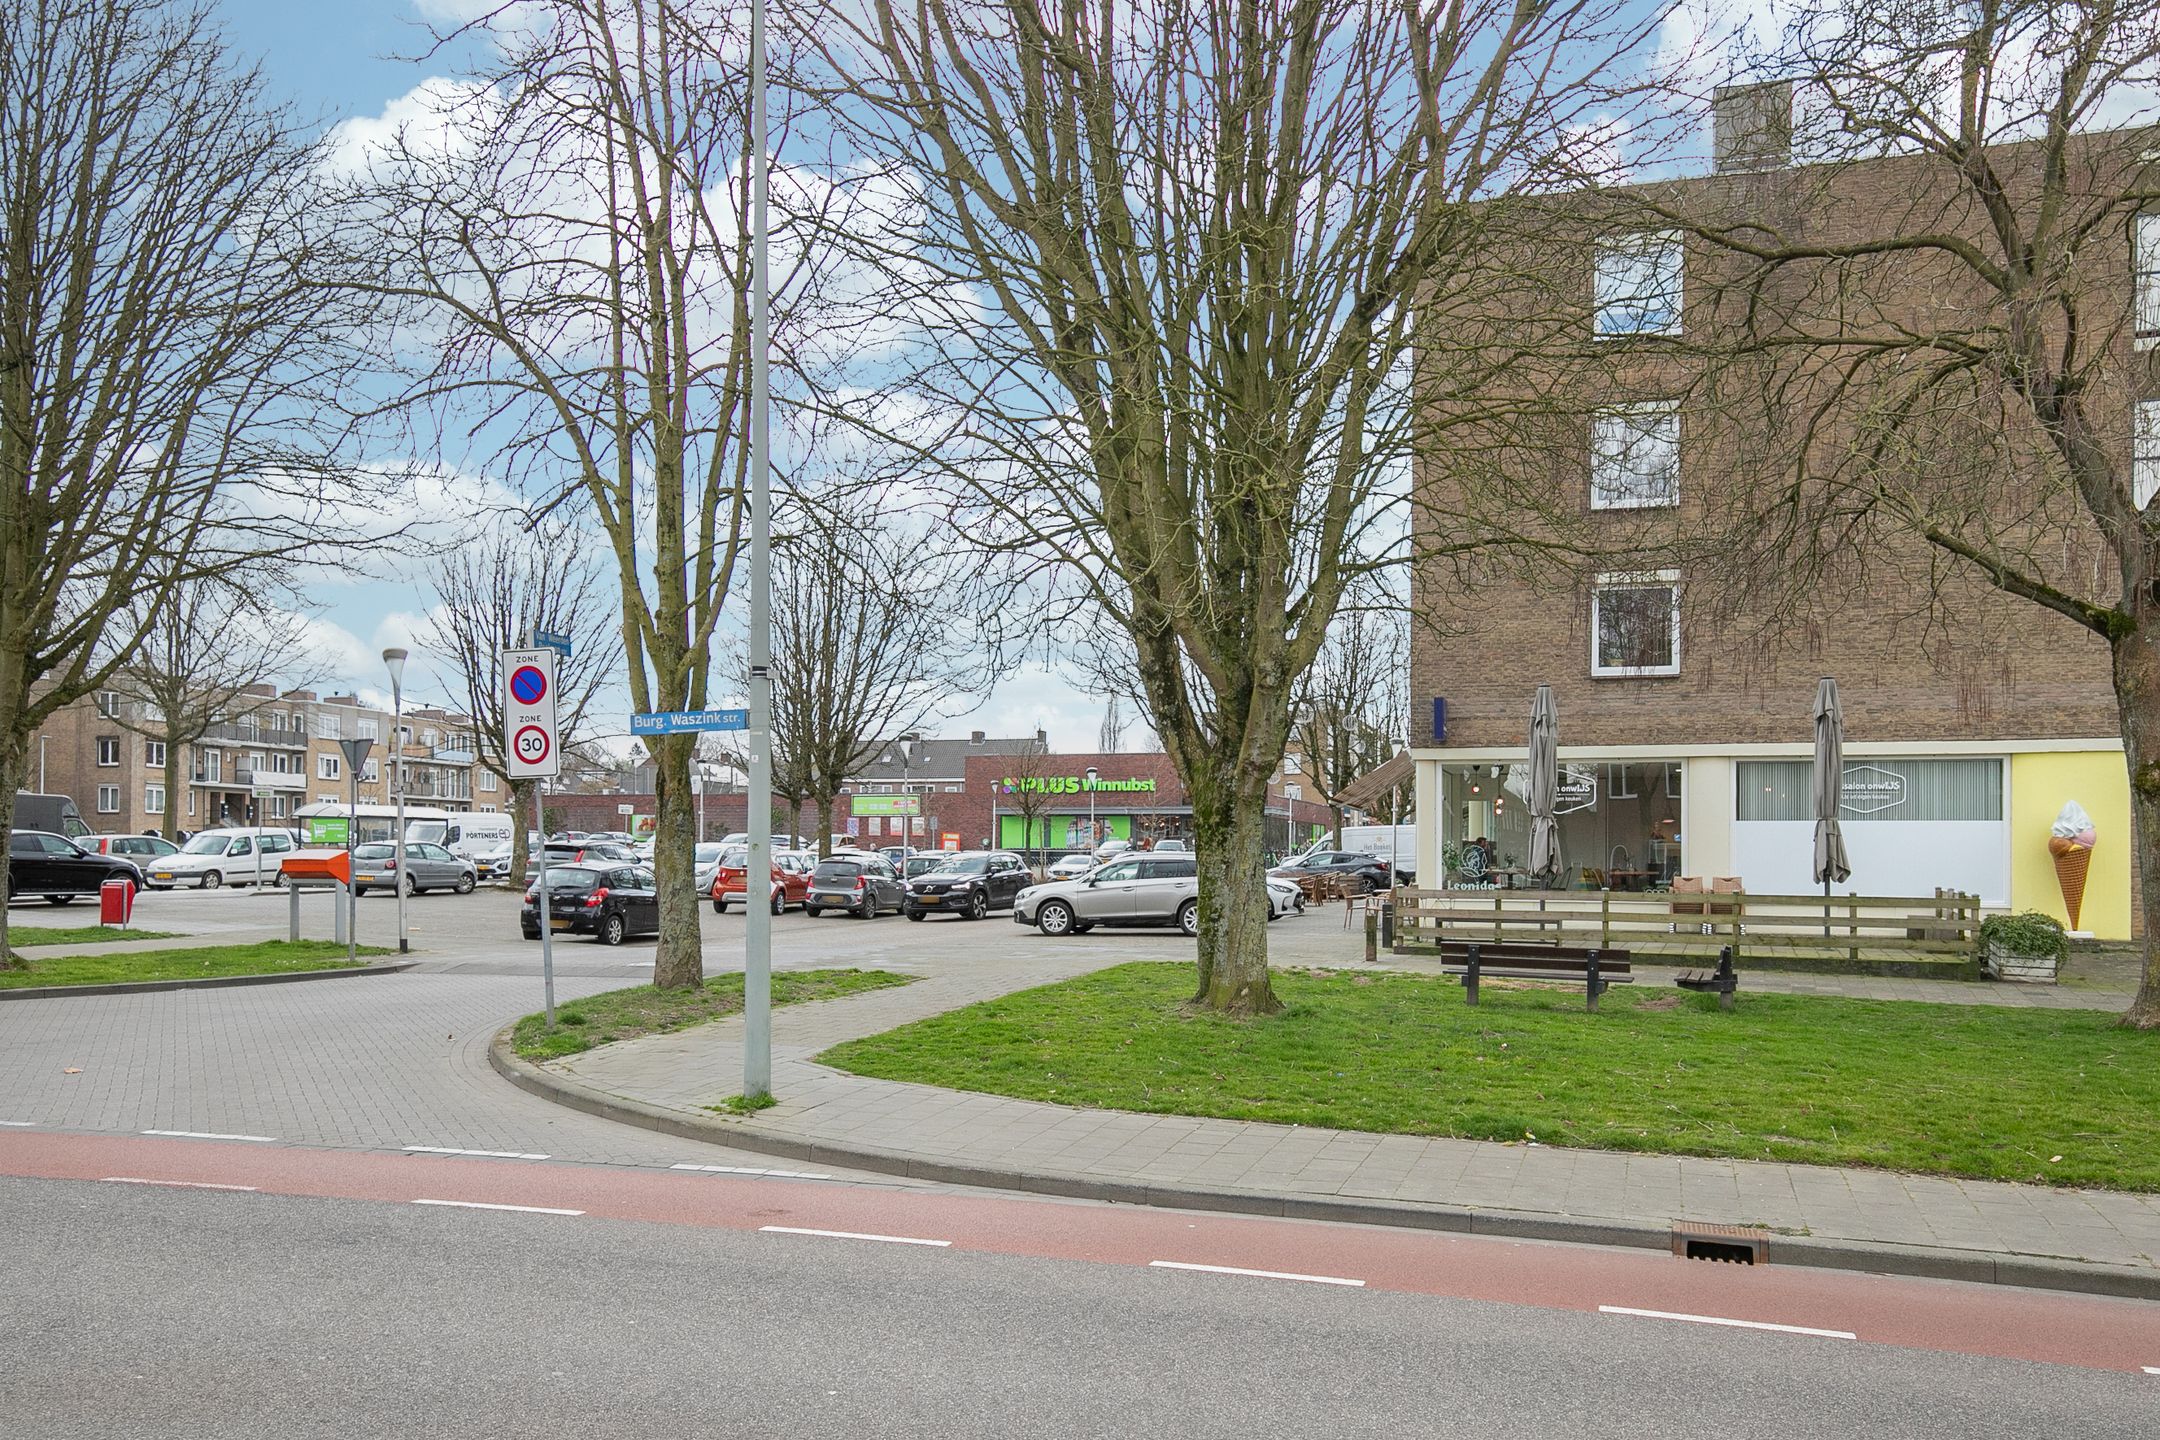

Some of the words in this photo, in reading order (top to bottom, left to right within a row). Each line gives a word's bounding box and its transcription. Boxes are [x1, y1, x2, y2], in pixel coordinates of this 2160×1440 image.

[519, 715, 542, 723] ZONE
[634, 715, 667, 729] Burg.
[670, 712, 720, 725] Waszink
[722, 714, 741, 723] str.
[521, 737, 543, 752] 30
[1021, 776, 1080, 794] PLUS
[1080, 777, 1156, 792] Winnubst
[1560, 784, 1591, 793] onwIJS
[1867, 781, 1901, 790] onwIJS
